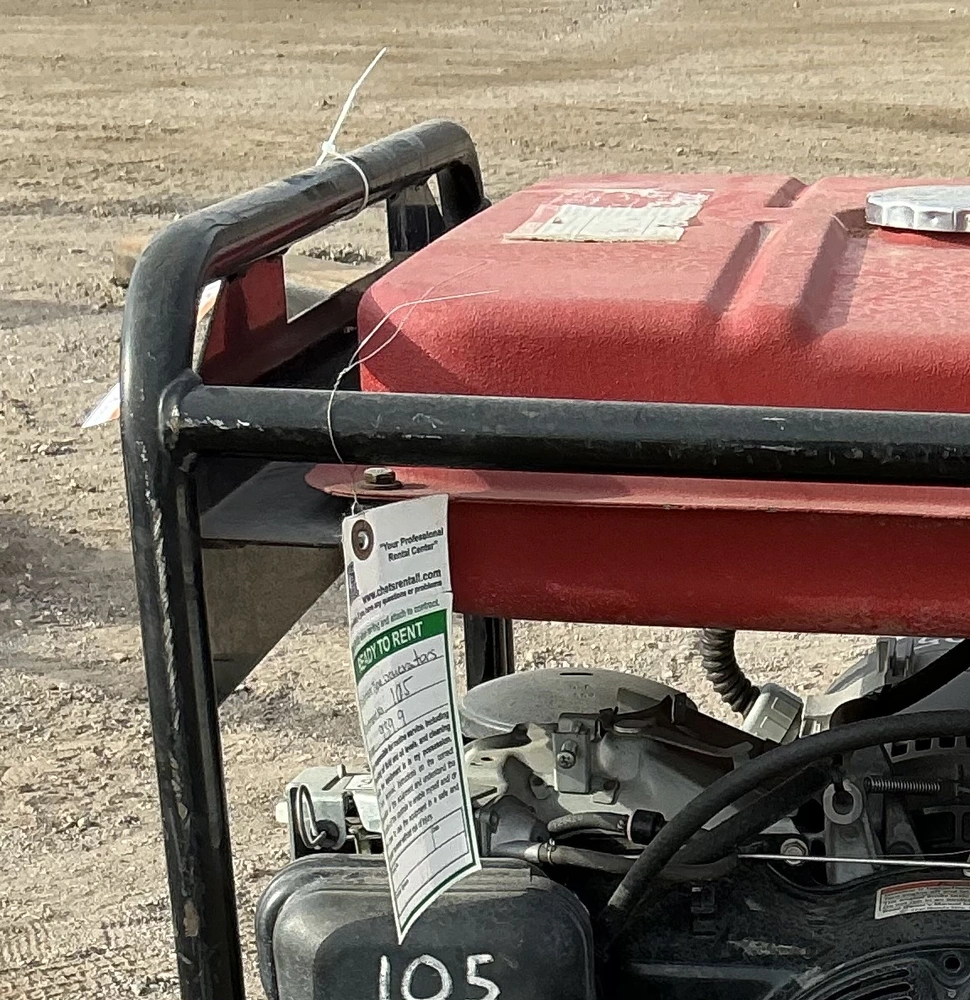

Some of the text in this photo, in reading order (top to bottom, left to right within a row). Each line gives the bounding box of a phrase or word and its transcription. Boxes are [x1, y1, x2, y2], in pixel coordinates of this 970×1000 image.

[400, 526, 444, 546] Professional
[388, 547, 410, 562] Rental
[378, 636, 391, 655] TO
[392, 621, 424, 648] RENT
